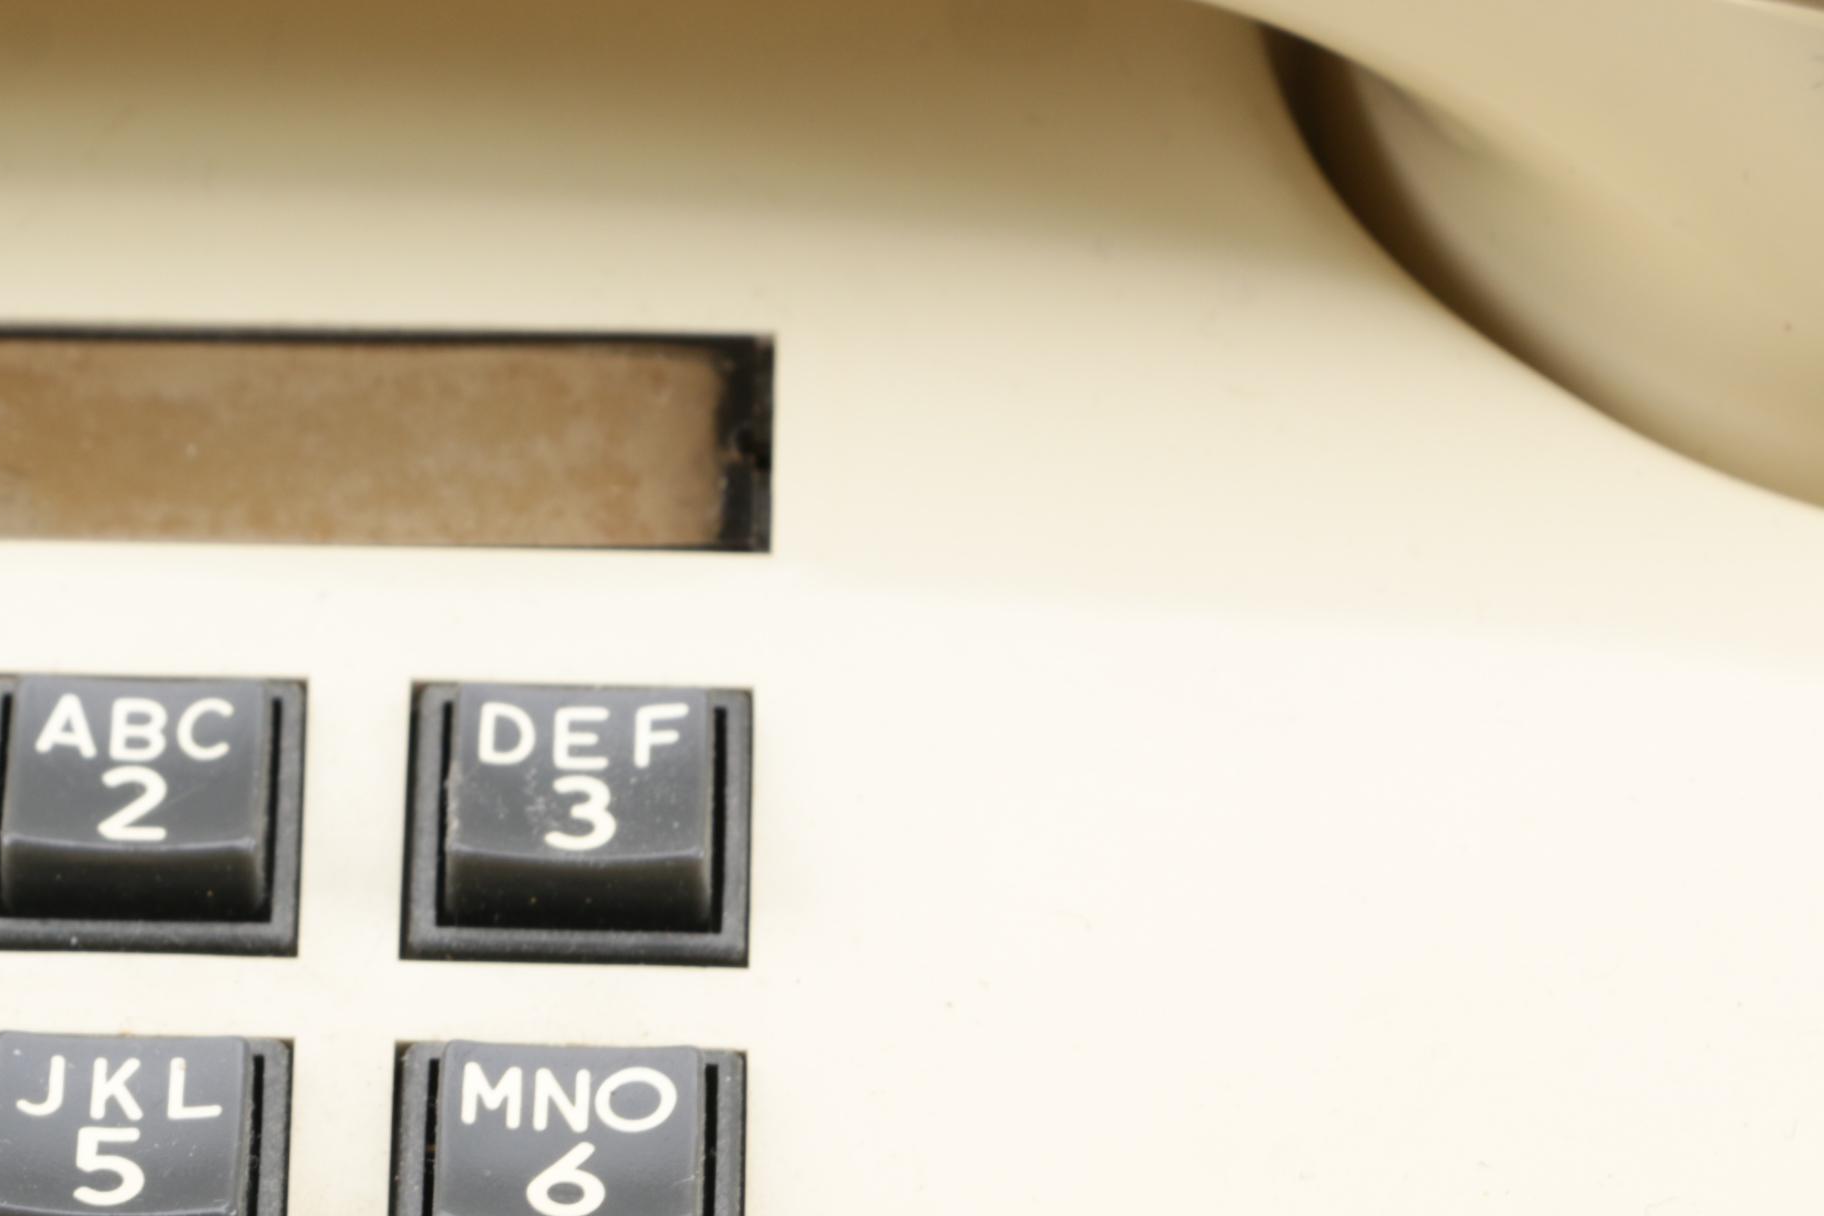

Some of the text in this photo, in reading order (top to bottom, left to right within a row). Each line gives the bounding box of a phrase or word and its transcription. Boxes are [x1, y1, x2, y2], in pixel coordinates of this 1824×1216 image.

[34, 692, 237, 764] ABC
[478, 700, 690, 771] DEF
[97, 764, 168, 843] 2
[543, 774, 618, 853] 3
[15, 1054, 224, 1122] JKL
[459, 1061, 678, 1135] MNO
[72, 1125, 146, 1207] 5
